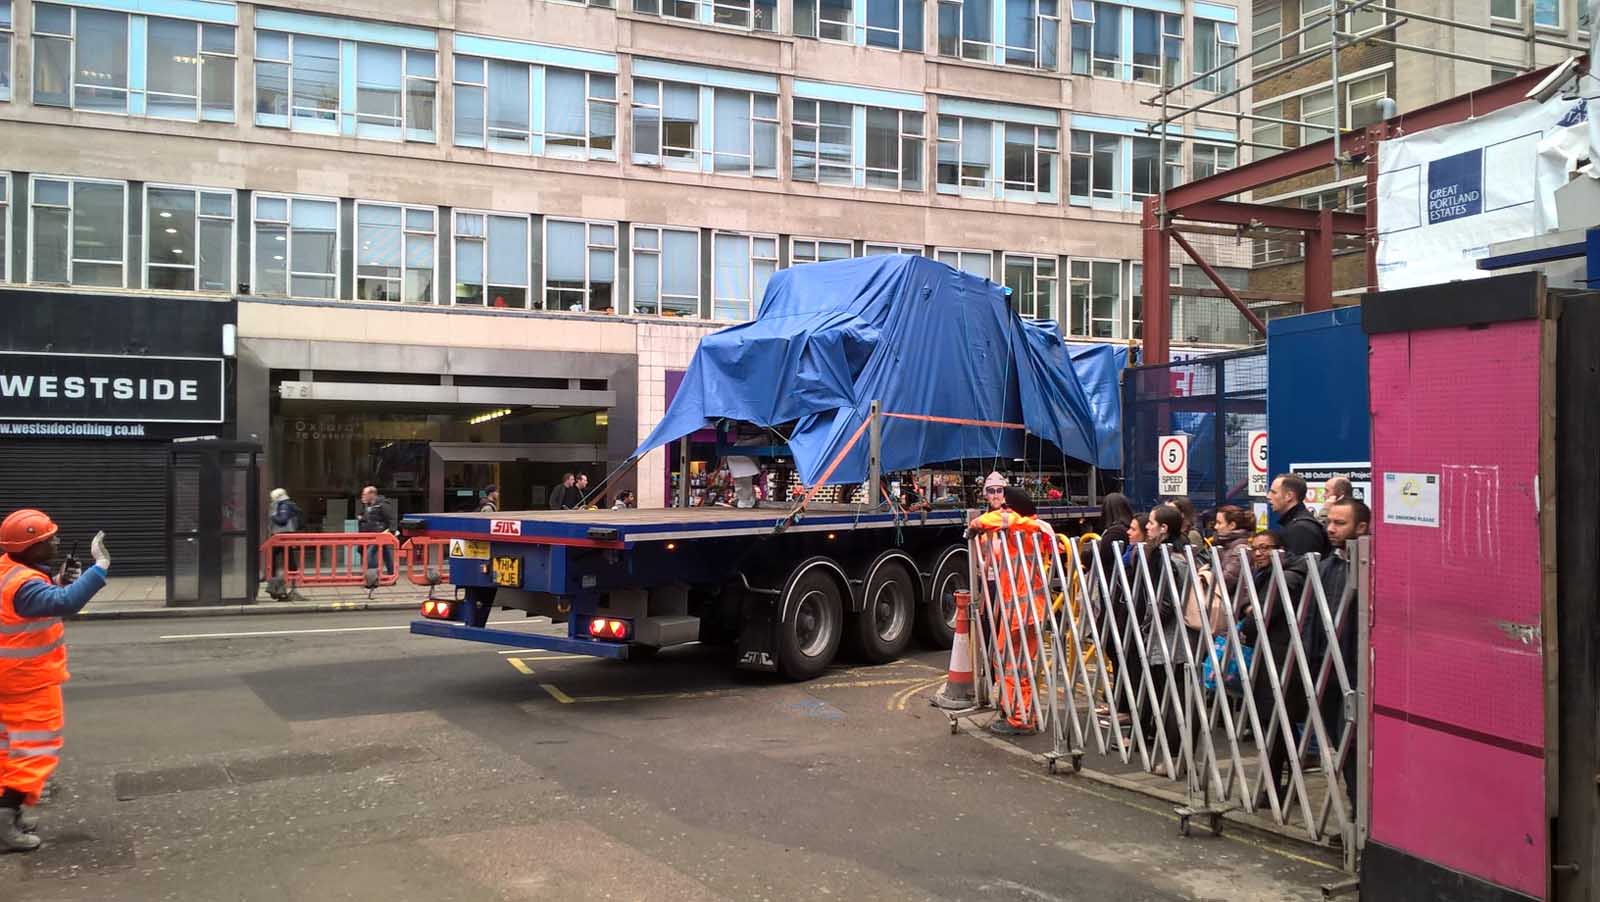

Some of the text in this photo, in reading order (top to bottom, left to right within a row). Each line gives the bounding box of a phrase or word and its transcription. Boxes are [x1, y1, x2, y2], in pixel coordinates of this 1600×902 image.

[1430, 184, 1458, 200] GREAT
[1430, 190, 1480, 210] PORTLAND
[1430, 204, 1467, 220] ESTATES
[0, 375, 198, 401] WESTSIDE
[1168, 448, 1177, 464] 5
[1259, 444, 1268, 461] 5
[1161, 475, 1184, 484] SPEED
[1252, 474, 1268, 483] SPE
[1163, 484, 1181, 493] LIMIT
[1254, 484, 1268, 493] LIM
